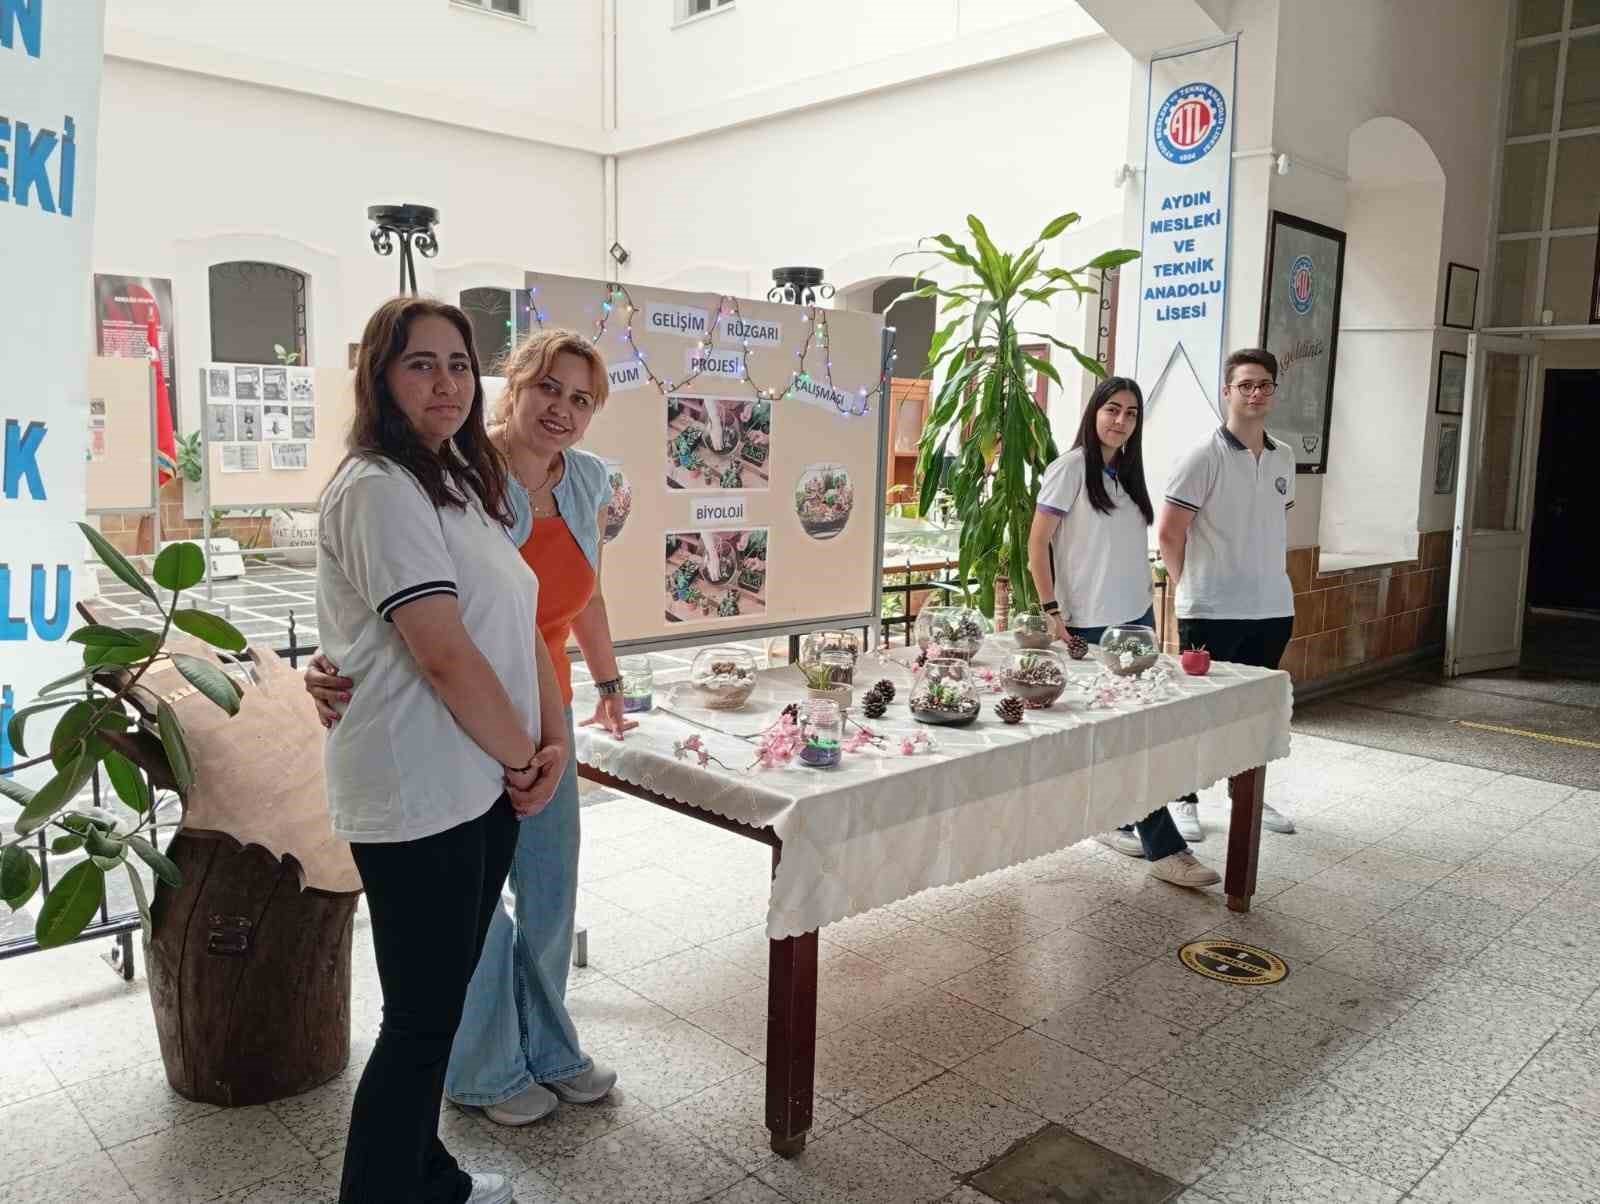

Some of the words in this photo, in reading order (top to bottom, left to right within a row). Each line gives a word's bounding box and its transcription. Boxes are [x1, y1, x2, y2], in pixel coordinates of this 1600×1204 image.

[1161, 191, 1211, 211] AYDIN
[1150, 208, 1221, 234] MESLEKİ
[1173, 239, 1196, 254] VE
[1153, 257, 1214, 278] TEKNİK
[1143, 280, 1221, 300] ANADOLU
[1156, 301, 1206, 321] LİSESİ
[651, 312, 705, 332] GELİŞİM
[726, 320, 779, 341] RÜZGARI
[690, 357, 740, 373] PROJESİ
[608, 367, 640, 385] YUM
[696, 504, 744, 520] BİYOLOJİ
